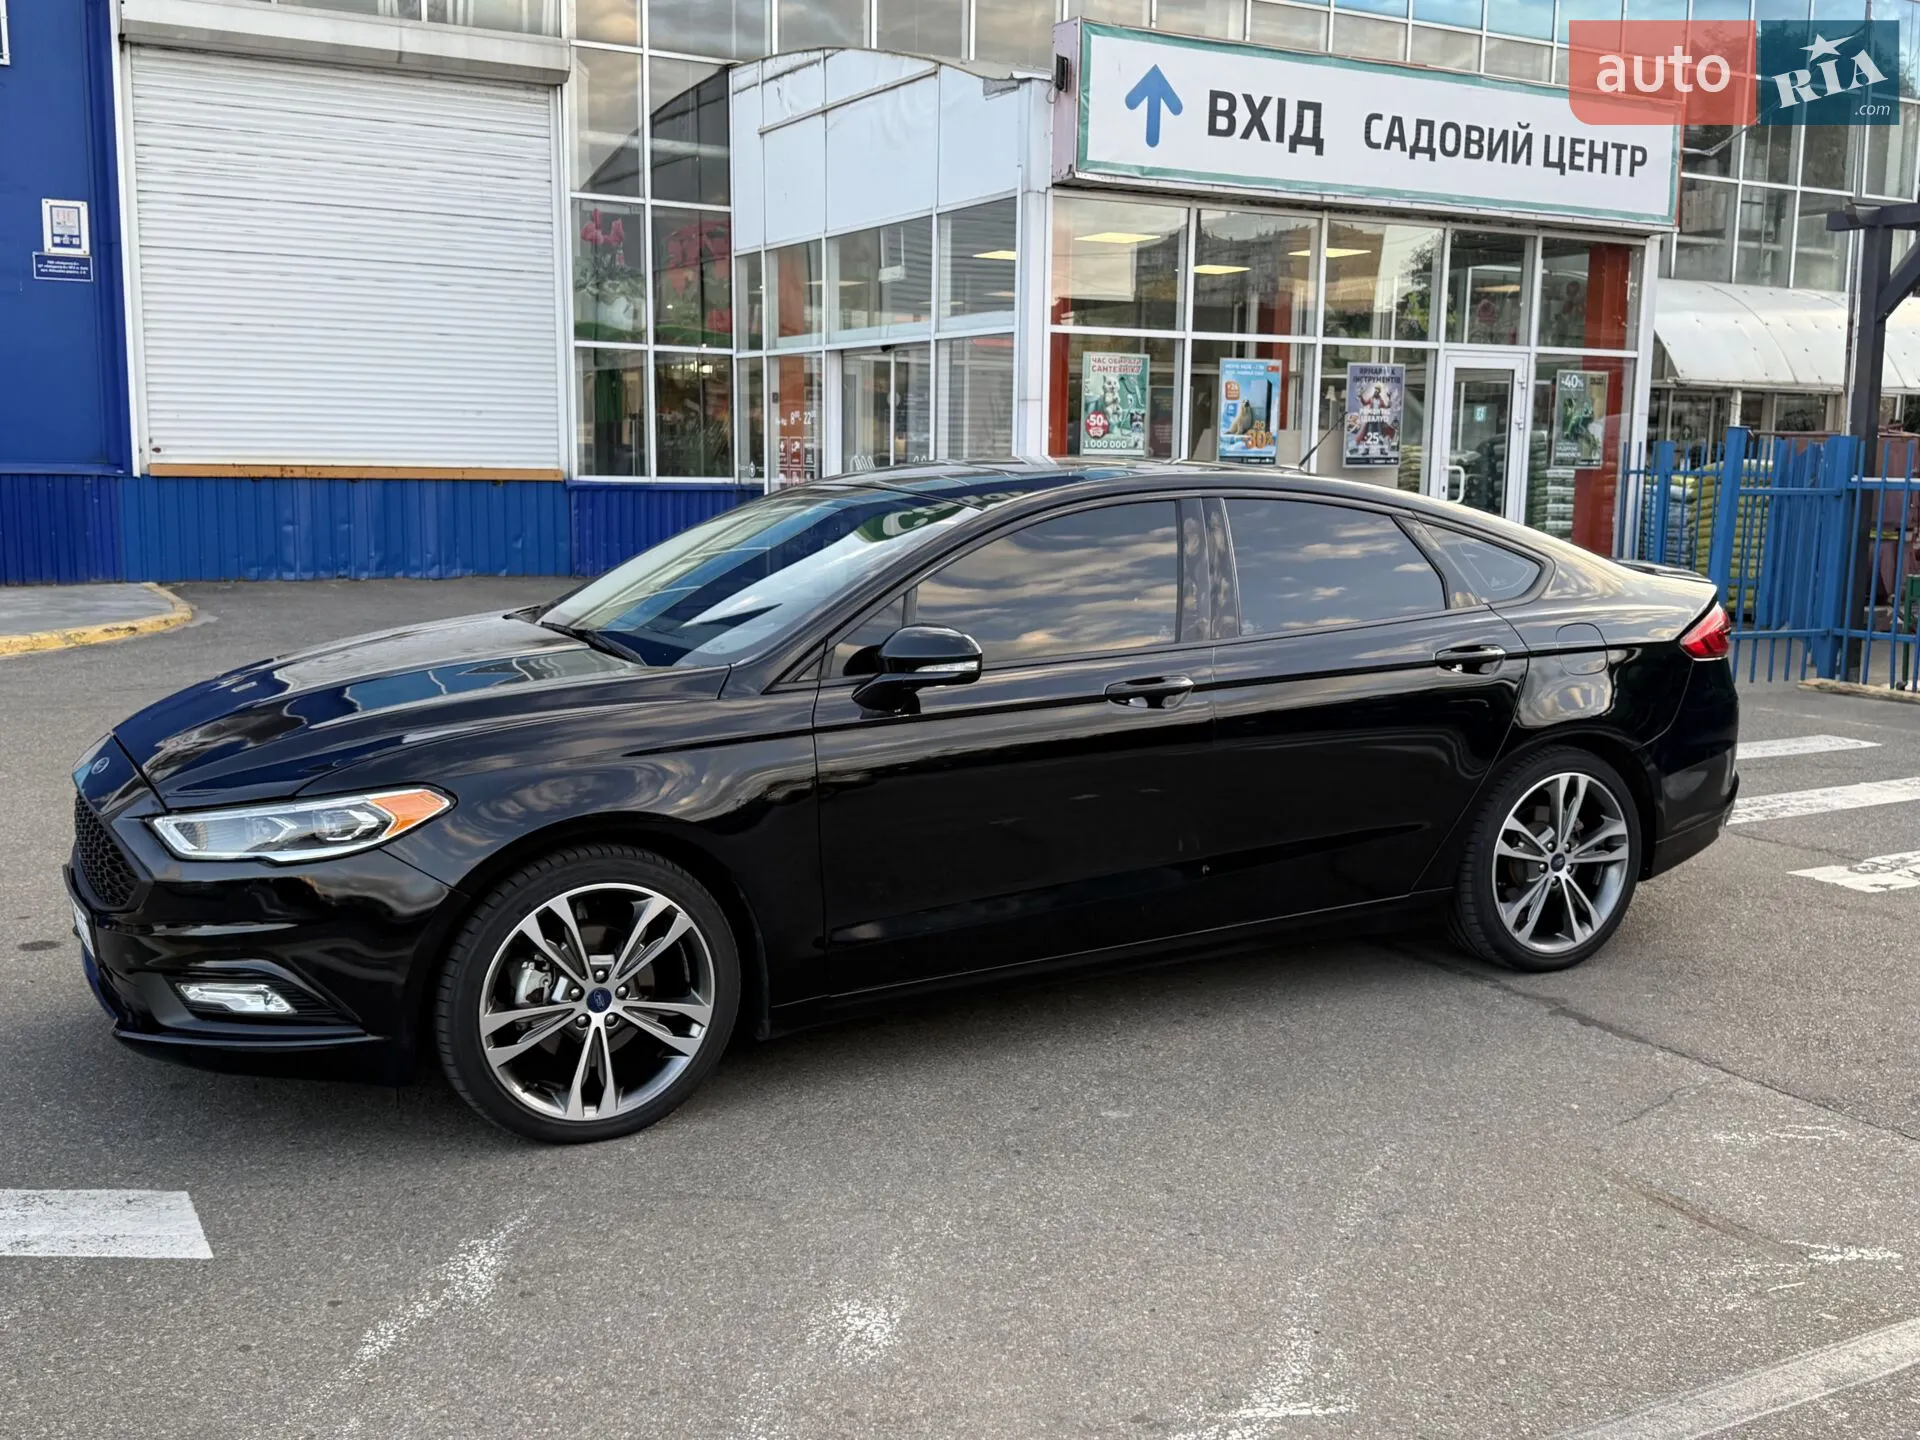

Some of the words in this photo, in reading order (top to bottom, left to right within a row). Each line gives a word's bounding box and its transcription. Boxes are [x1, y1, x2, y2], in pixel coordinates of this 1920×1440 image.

[1207, 89, 1324, 156] ВХІД
[1364, 112, 1533, 166] САДОВИЙ
[1543, 134, 1648, 177] ЦЕНТР
